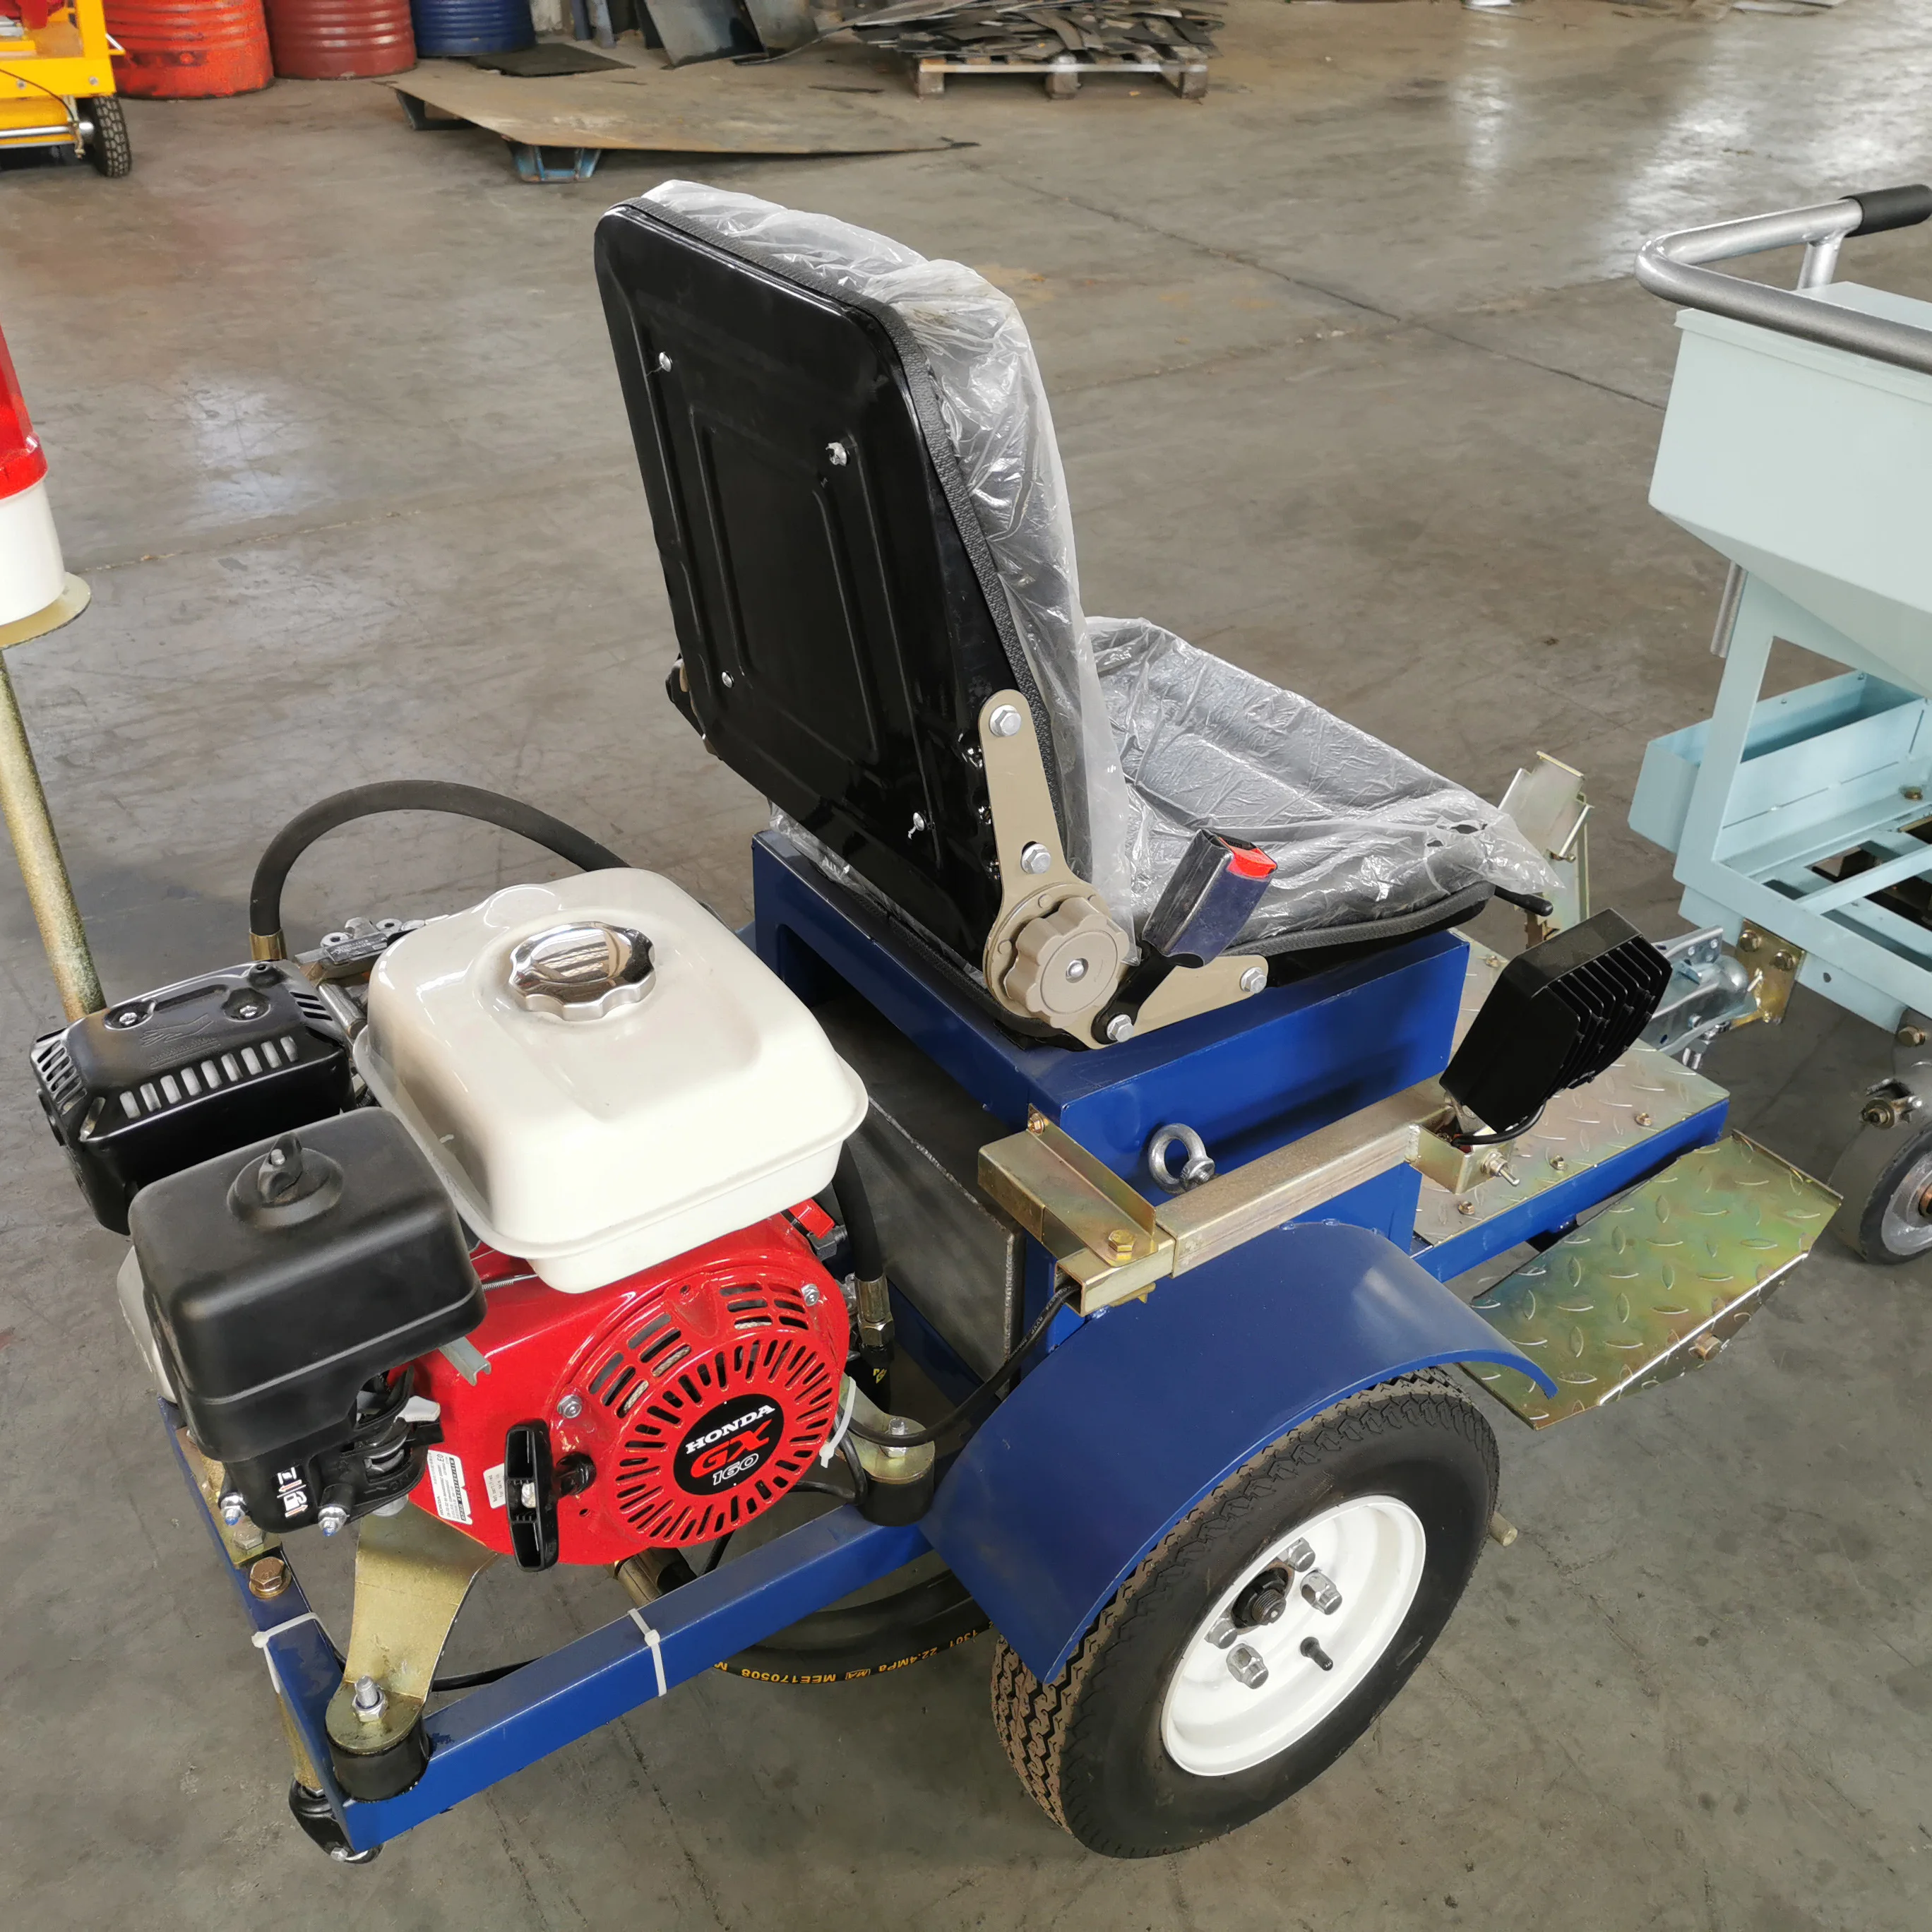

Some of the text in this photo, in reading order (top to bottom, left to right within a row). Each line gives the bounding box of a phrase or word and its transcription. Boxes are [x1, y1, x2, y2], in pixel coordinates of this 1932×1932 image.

[686, 1405, 775, 1454] HONDA
[691, 1419, 772, 1478] GX
[713, 1453, 759, 1486] 160
[741, 1669, 836, 1683] MEE170508
[878, 1647, 938, 1672] 22.4MPa
